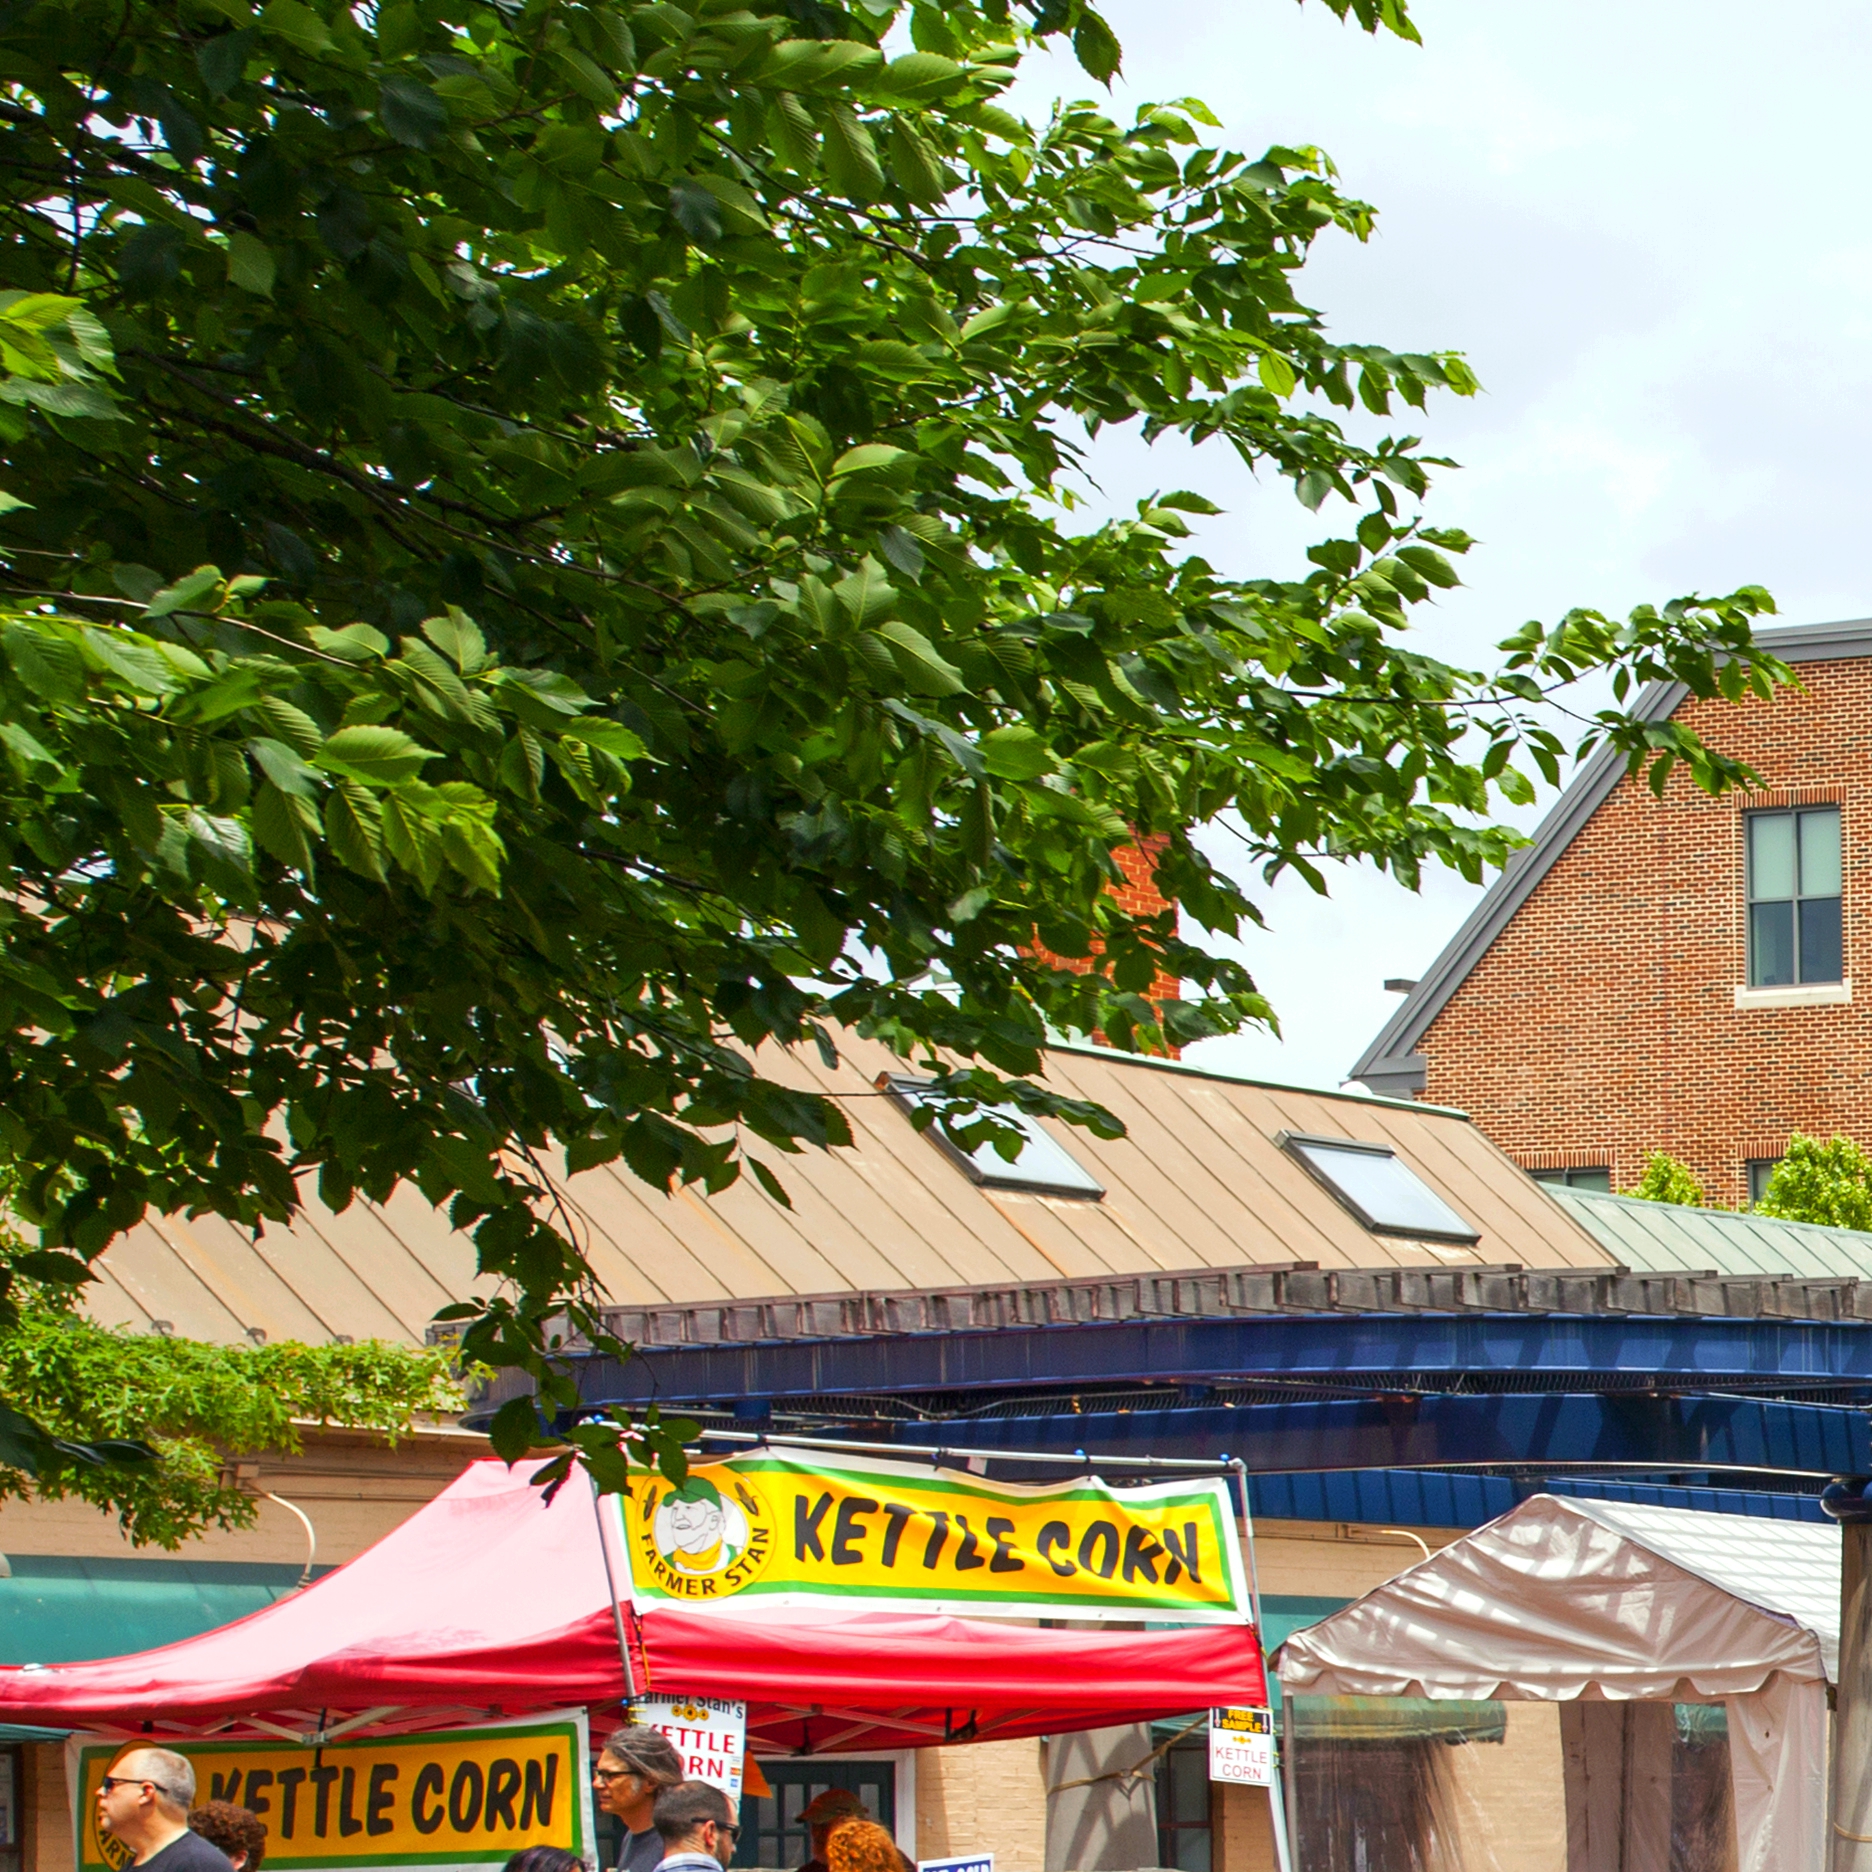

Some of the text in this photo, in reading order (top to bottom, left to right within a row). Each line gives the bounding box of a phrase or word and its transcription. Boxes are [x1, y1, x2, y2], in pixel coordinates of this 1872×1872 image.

[794, 1491, 1202, 1585] KETTLE CORN
[641, 1527, 770, 1596] FARMER STAN
[1222, 1718, 1262, 1733] SAMPLE
[1227, 1709, 1254, 1721] FREE
[652, 1724, 735, 1754] ETTLE
[1215, 1746, 1267, 1764] KETTLE
[1222, 1763, 1261, 1780] CORN
[411, 1753, 559, 1835] CORN
